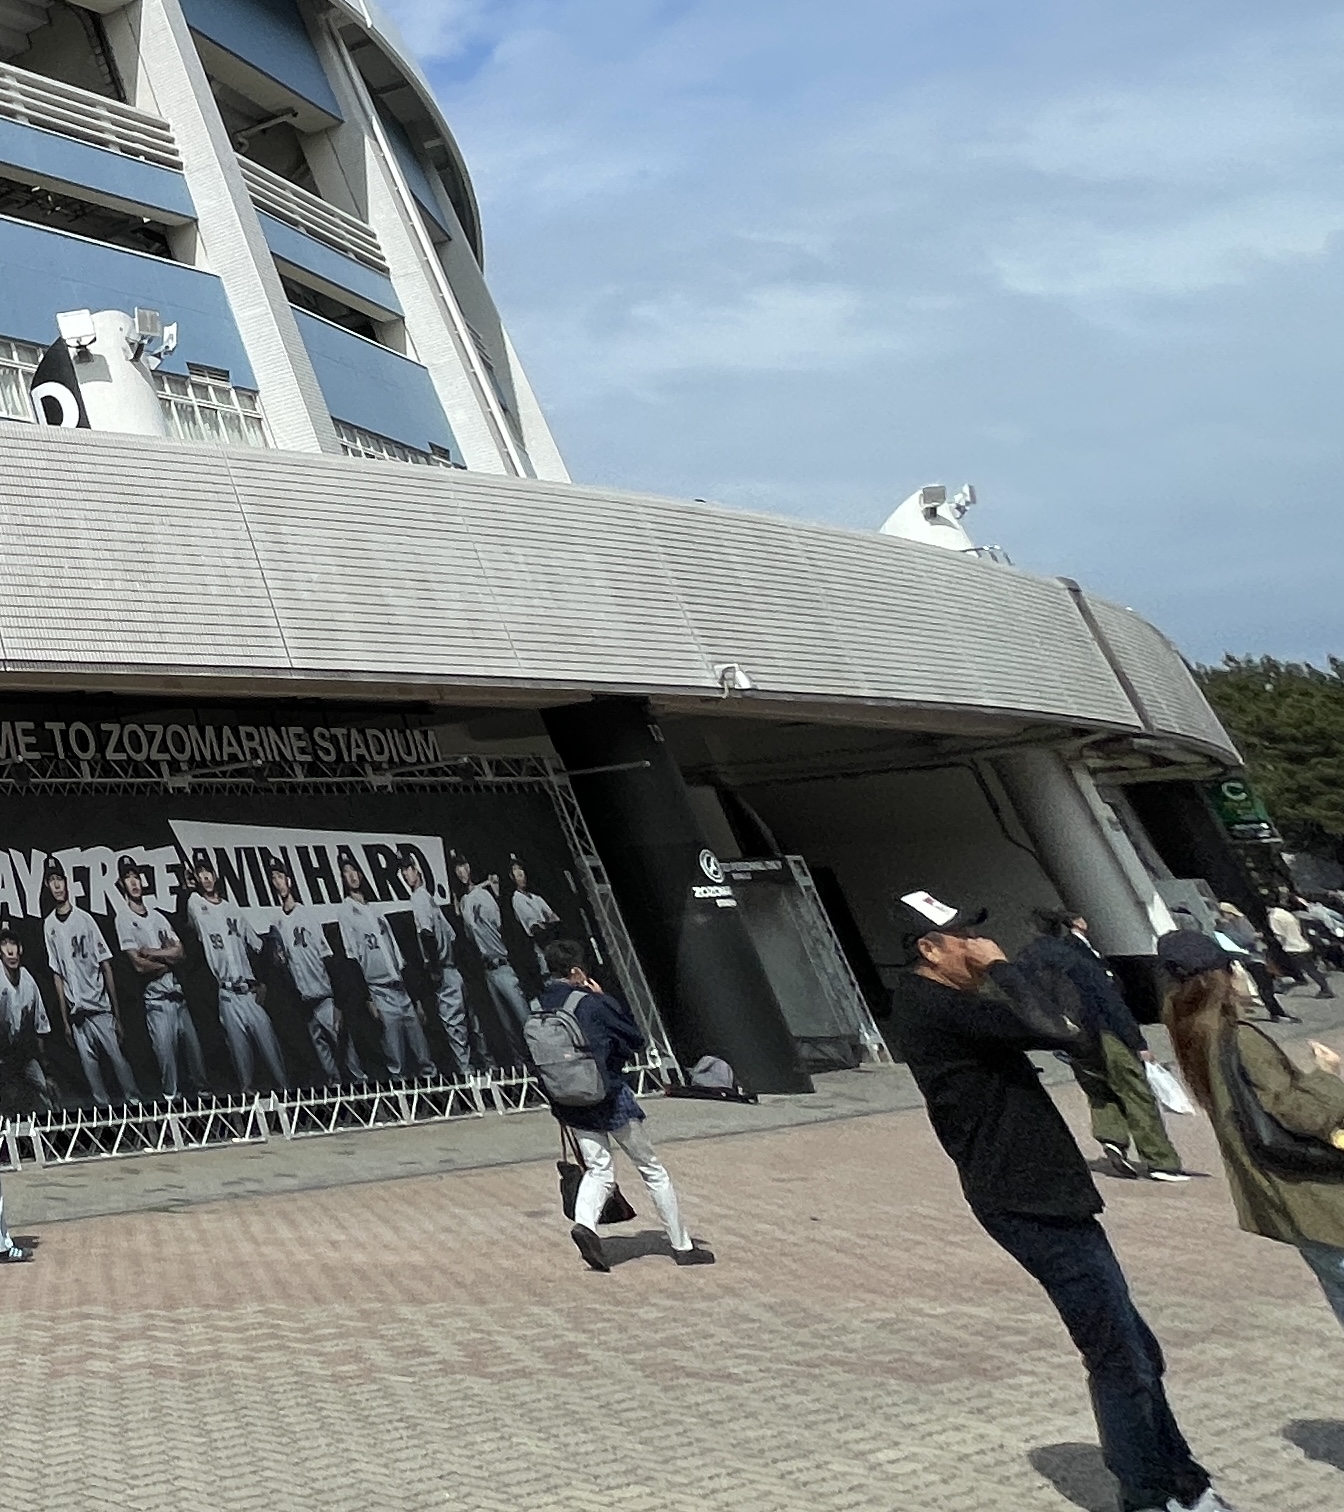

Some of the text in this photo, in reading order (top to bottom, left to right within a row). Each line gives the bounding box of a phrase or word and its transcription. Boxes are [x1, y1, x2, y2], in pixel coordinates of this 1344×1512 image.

[44, 721, 96, 760] TO
[100, 723, 312, 762] ZOZOMARINE
[313, 726, 442, 763] STADIUM
